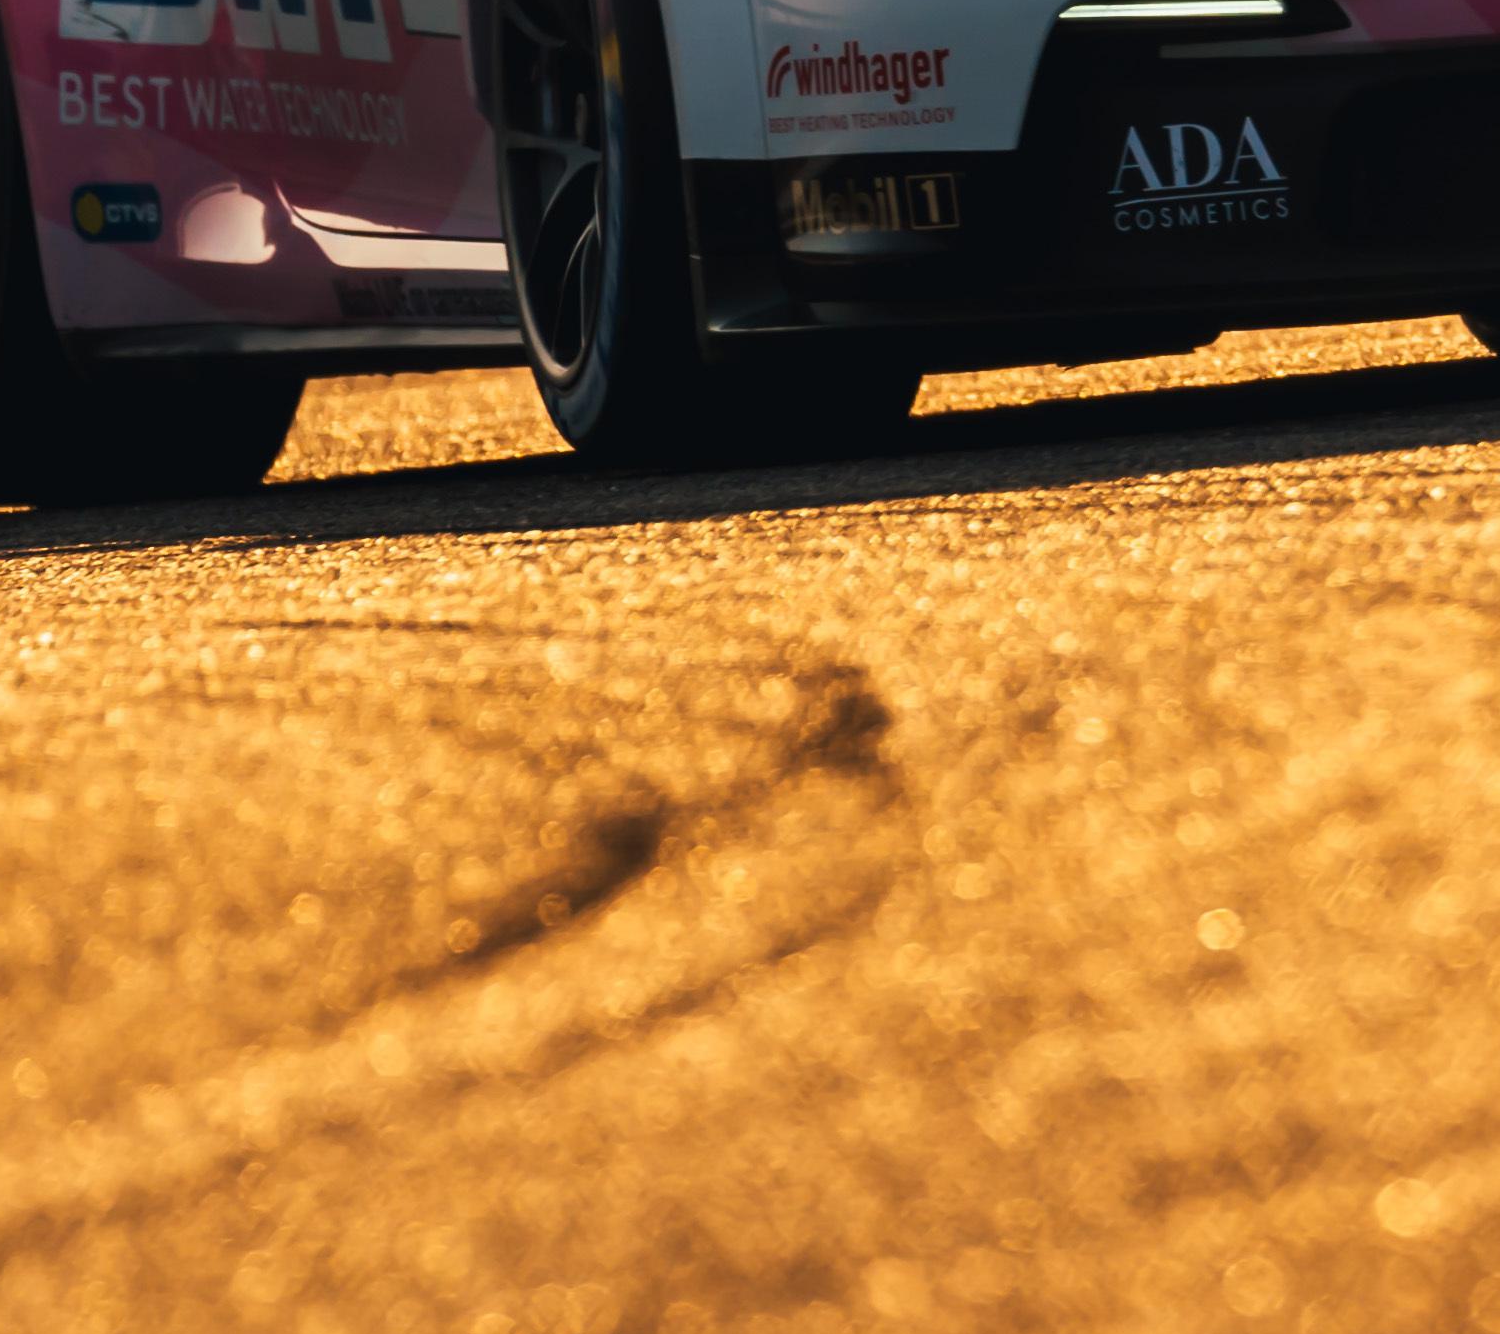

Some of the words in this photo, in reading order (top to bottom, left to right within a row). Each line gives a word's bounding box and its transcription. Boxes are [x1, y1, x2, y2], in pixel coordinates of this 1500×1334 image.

[57, 71, 171, 130] BEST
[181, 77, 272, 132] WATER
[793, 39, 950, 104] windhager
[851, 107, 957, 130] TECHNOLOGY
[1108, 116, 1288, 195] ADA
[790, 176, 901, 235] Mobil
[919, 179, 941, 224] 1
[1114, 197, 1290, 232] COSMETICS
